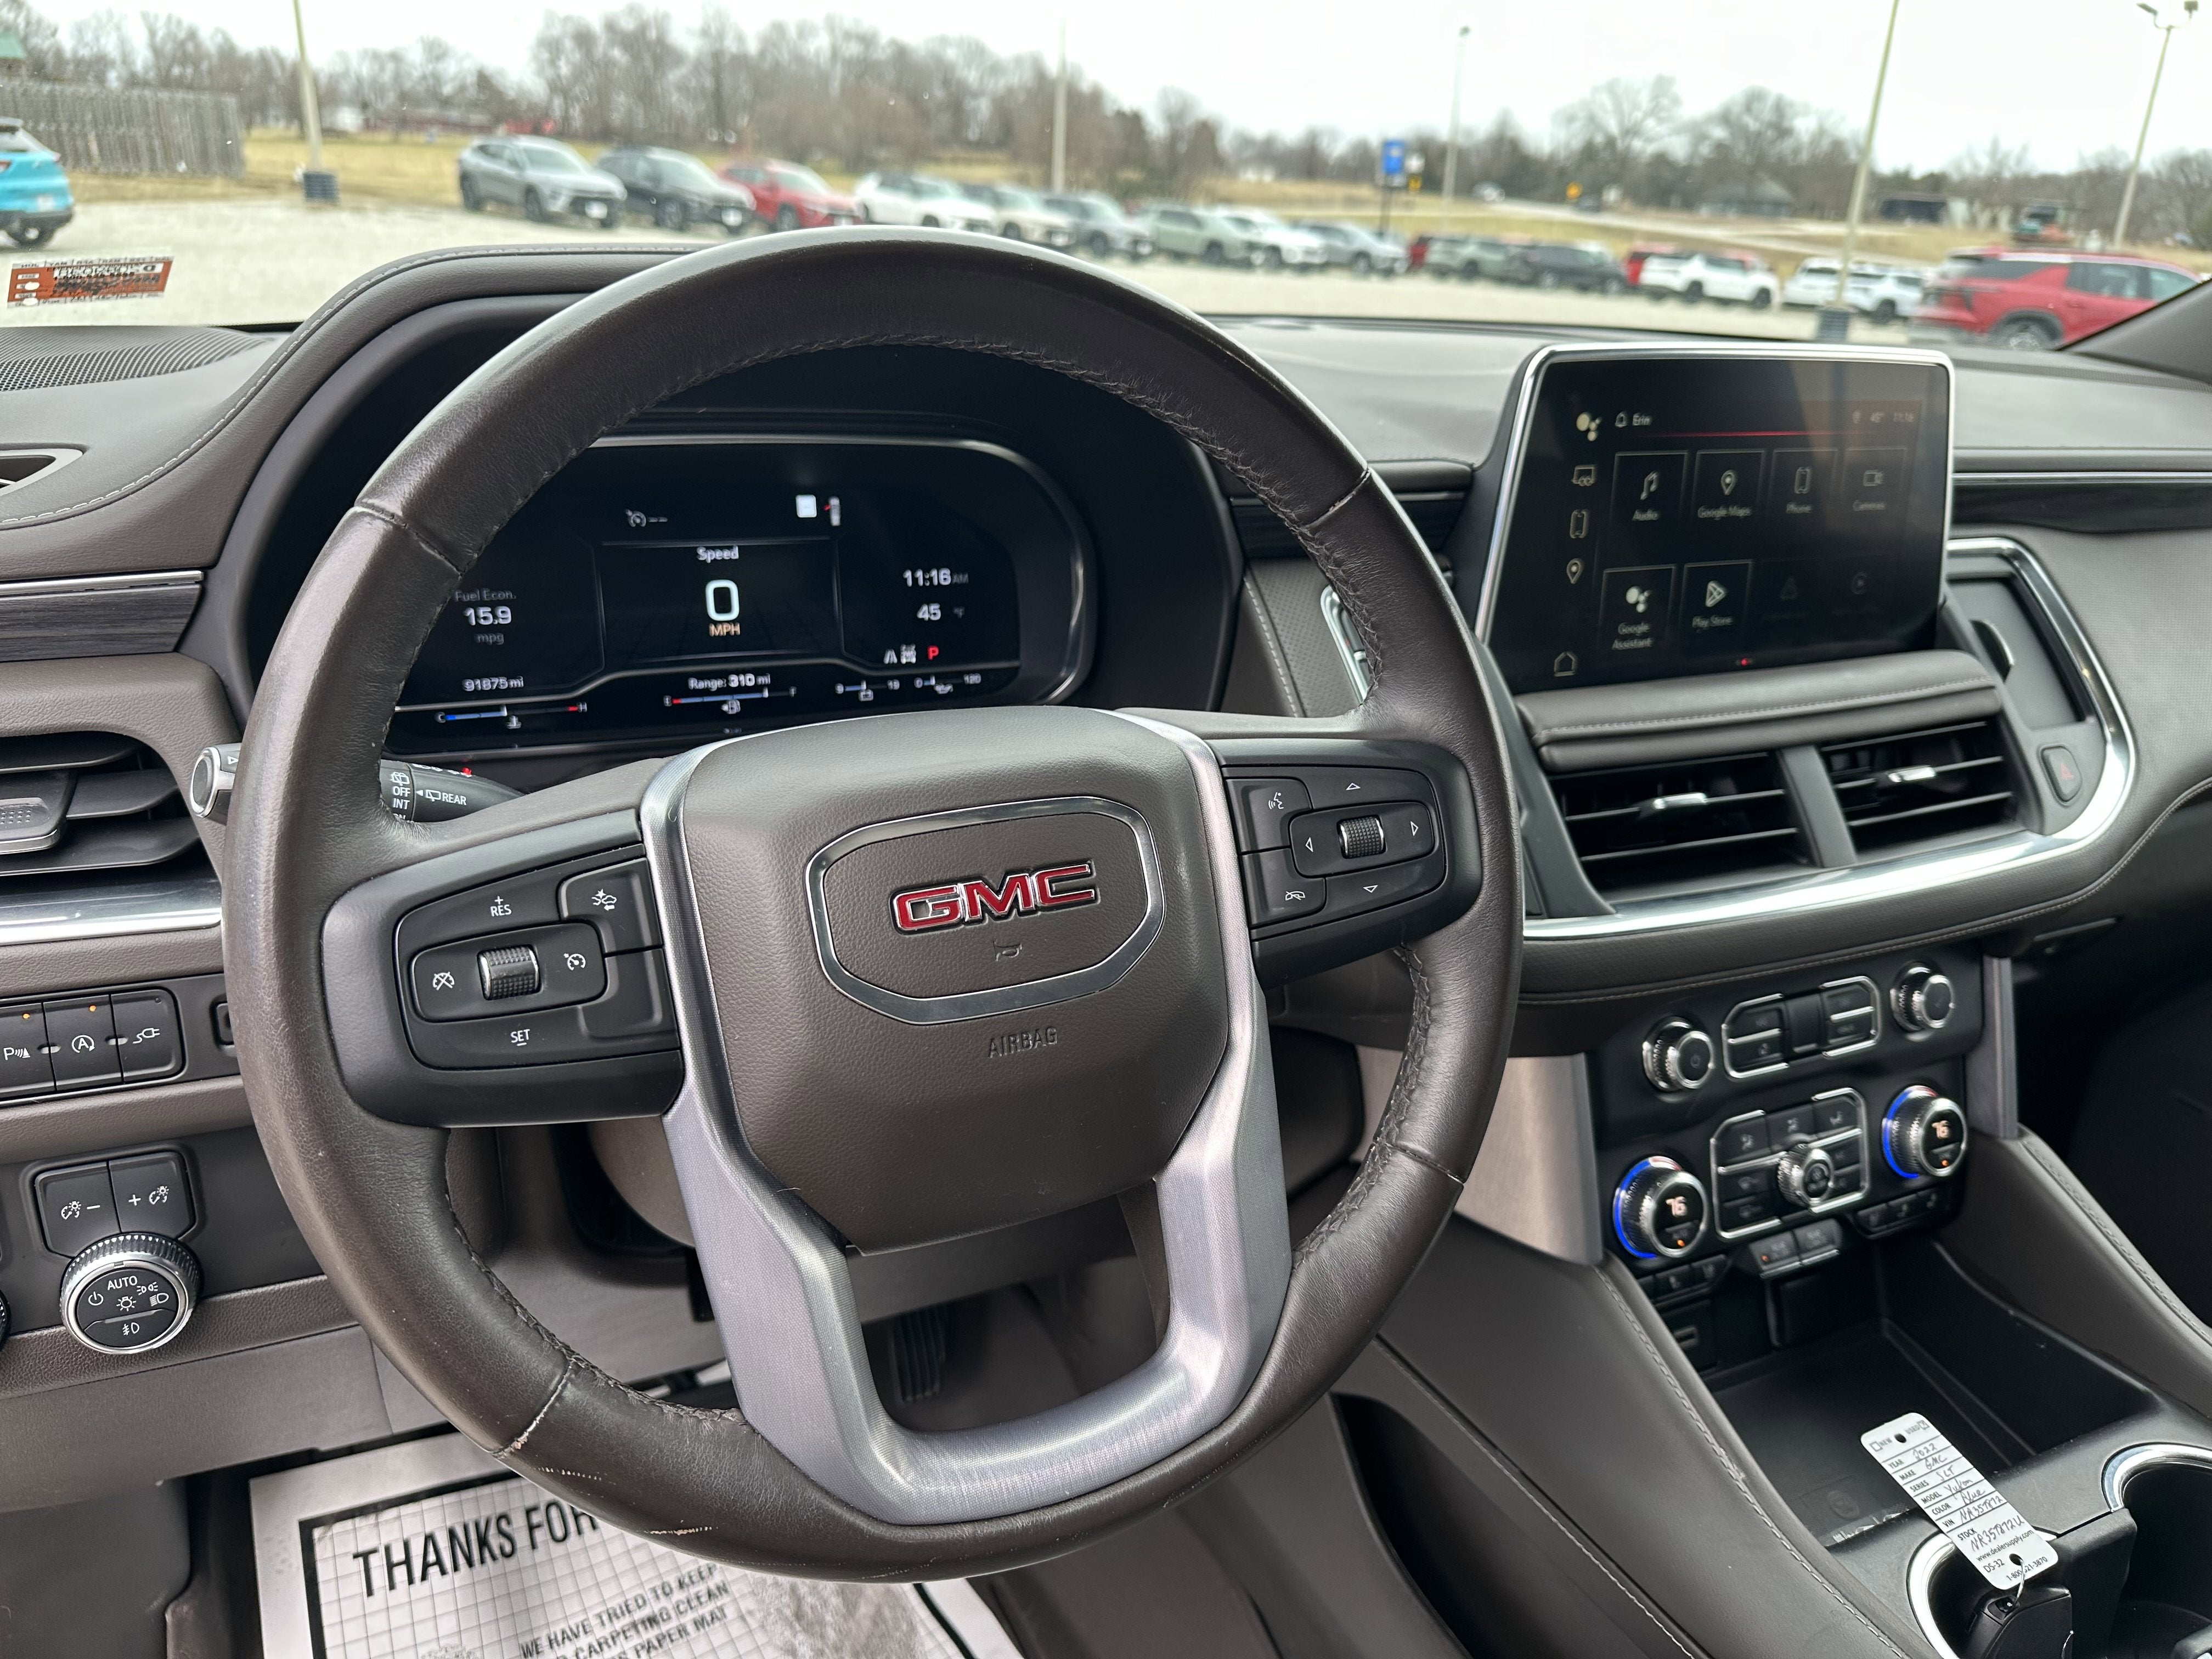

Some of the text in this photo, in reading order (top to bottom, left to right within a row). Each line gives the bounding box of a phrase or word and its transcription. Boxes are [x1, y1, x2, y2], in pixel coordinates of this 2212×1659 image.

[1631, 509, 1661, 522] Audio
[1696, 505, 1753, 521] Google Maps
[1785, 502, 1813, 515] Phone
[697, 545, 740, 563] Speed
[903, 567, 951, 587] 11:16
[454, 588, 516, 602] Fuel Econ.
[705, 579, 740, 622] 0
[464, 605, 512, 625] 15.9
[917, 603, 941, 621] 45
[709, 622, 741, 636] MPH
[1617, 621, 1651, 636] Google
[1691, 614, 1734, 633] Play Store
[475, 633, 505, 645] mpg
[1611, 637, 1654, 651] Assistant
[927, 645, 940, 661] P
[688, 676, 727, 691] Range:
[728, 673, 755, 687] 310
[392, 786, 410, 798] OFF
[442, 792, 467, 805] REAR
[392, 798, 410, 810] INT
[893, 862, 1097, 931] GMC
[490, 904, 512, 917] RES
[510, 1029, 531, 1043] SET
[988, 1027, 1058, 1058] AIRBAG
[107, 1275, 138, 1291] AUTO
[1878, 1437, 1893, 1447] NEW
[1912, 1442, 1938, 1460] 2022
[1887, 1458, 1904, 1469] YEAR
[1925, 1454, 1948, 1470] GMC
[1899, 1469, 1917, 1481] MAKE
[1936, 1464, 1956, 1482] SLT
[1909, 1479, 1929, 1492] SERIES
[1943, 1477, 1974, 1500] Yukon
[1921, 1491, 1943, 1504] MODEL
[1931, 1502, 1952, 1516] COLOR
[1942, 1518, 1956, 1528] VIN
[1957, 1527, 1978, 1541] STOCK
[353, 1500, 599, 1598] THANKS FOR
[1976, 1529, 2035, 1562] www.dealersupply.com
[1983, 1558, 2006, 1573] DS-32
[2006, 1556, 2048, 1582] 1-80021-3870
[521, 1562, 718, 1659] WE HAVE TRIED TO KEEP
[574, 1578, 731, 1659] CARPETING CLEAN
[635, 1603, 729, 1659] PAPER MAT
